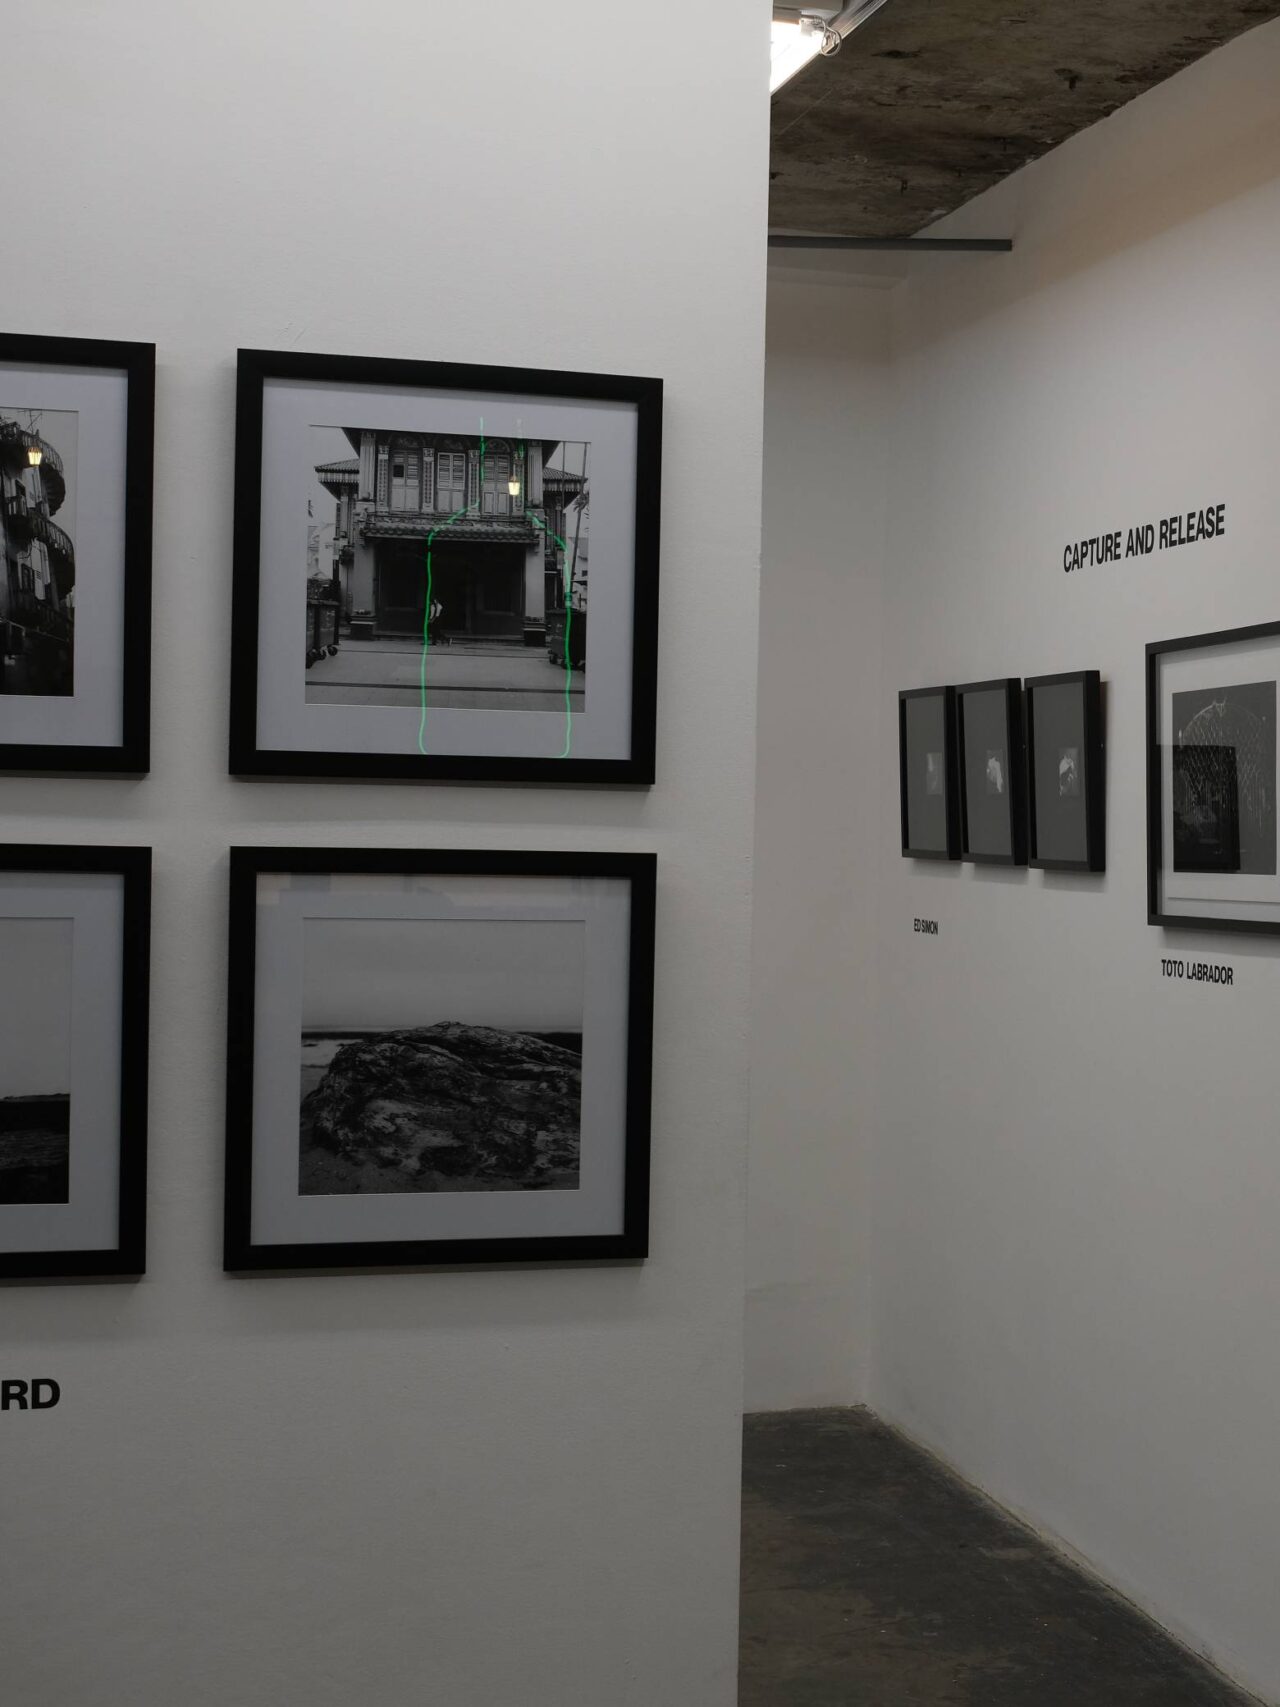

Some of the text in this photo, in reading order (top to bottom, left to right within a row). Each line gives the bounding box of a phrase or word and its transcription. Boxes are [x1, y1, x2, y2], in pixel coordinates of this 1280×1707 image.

[1063, 503, 1226, 573] CAPTURE AND RELEASE
[913, 918, 939, 935] ED SIMON
[1161, 958, 1234, 986] TOTO LABRADOR
[1, 1378, 61, 1411] RD
